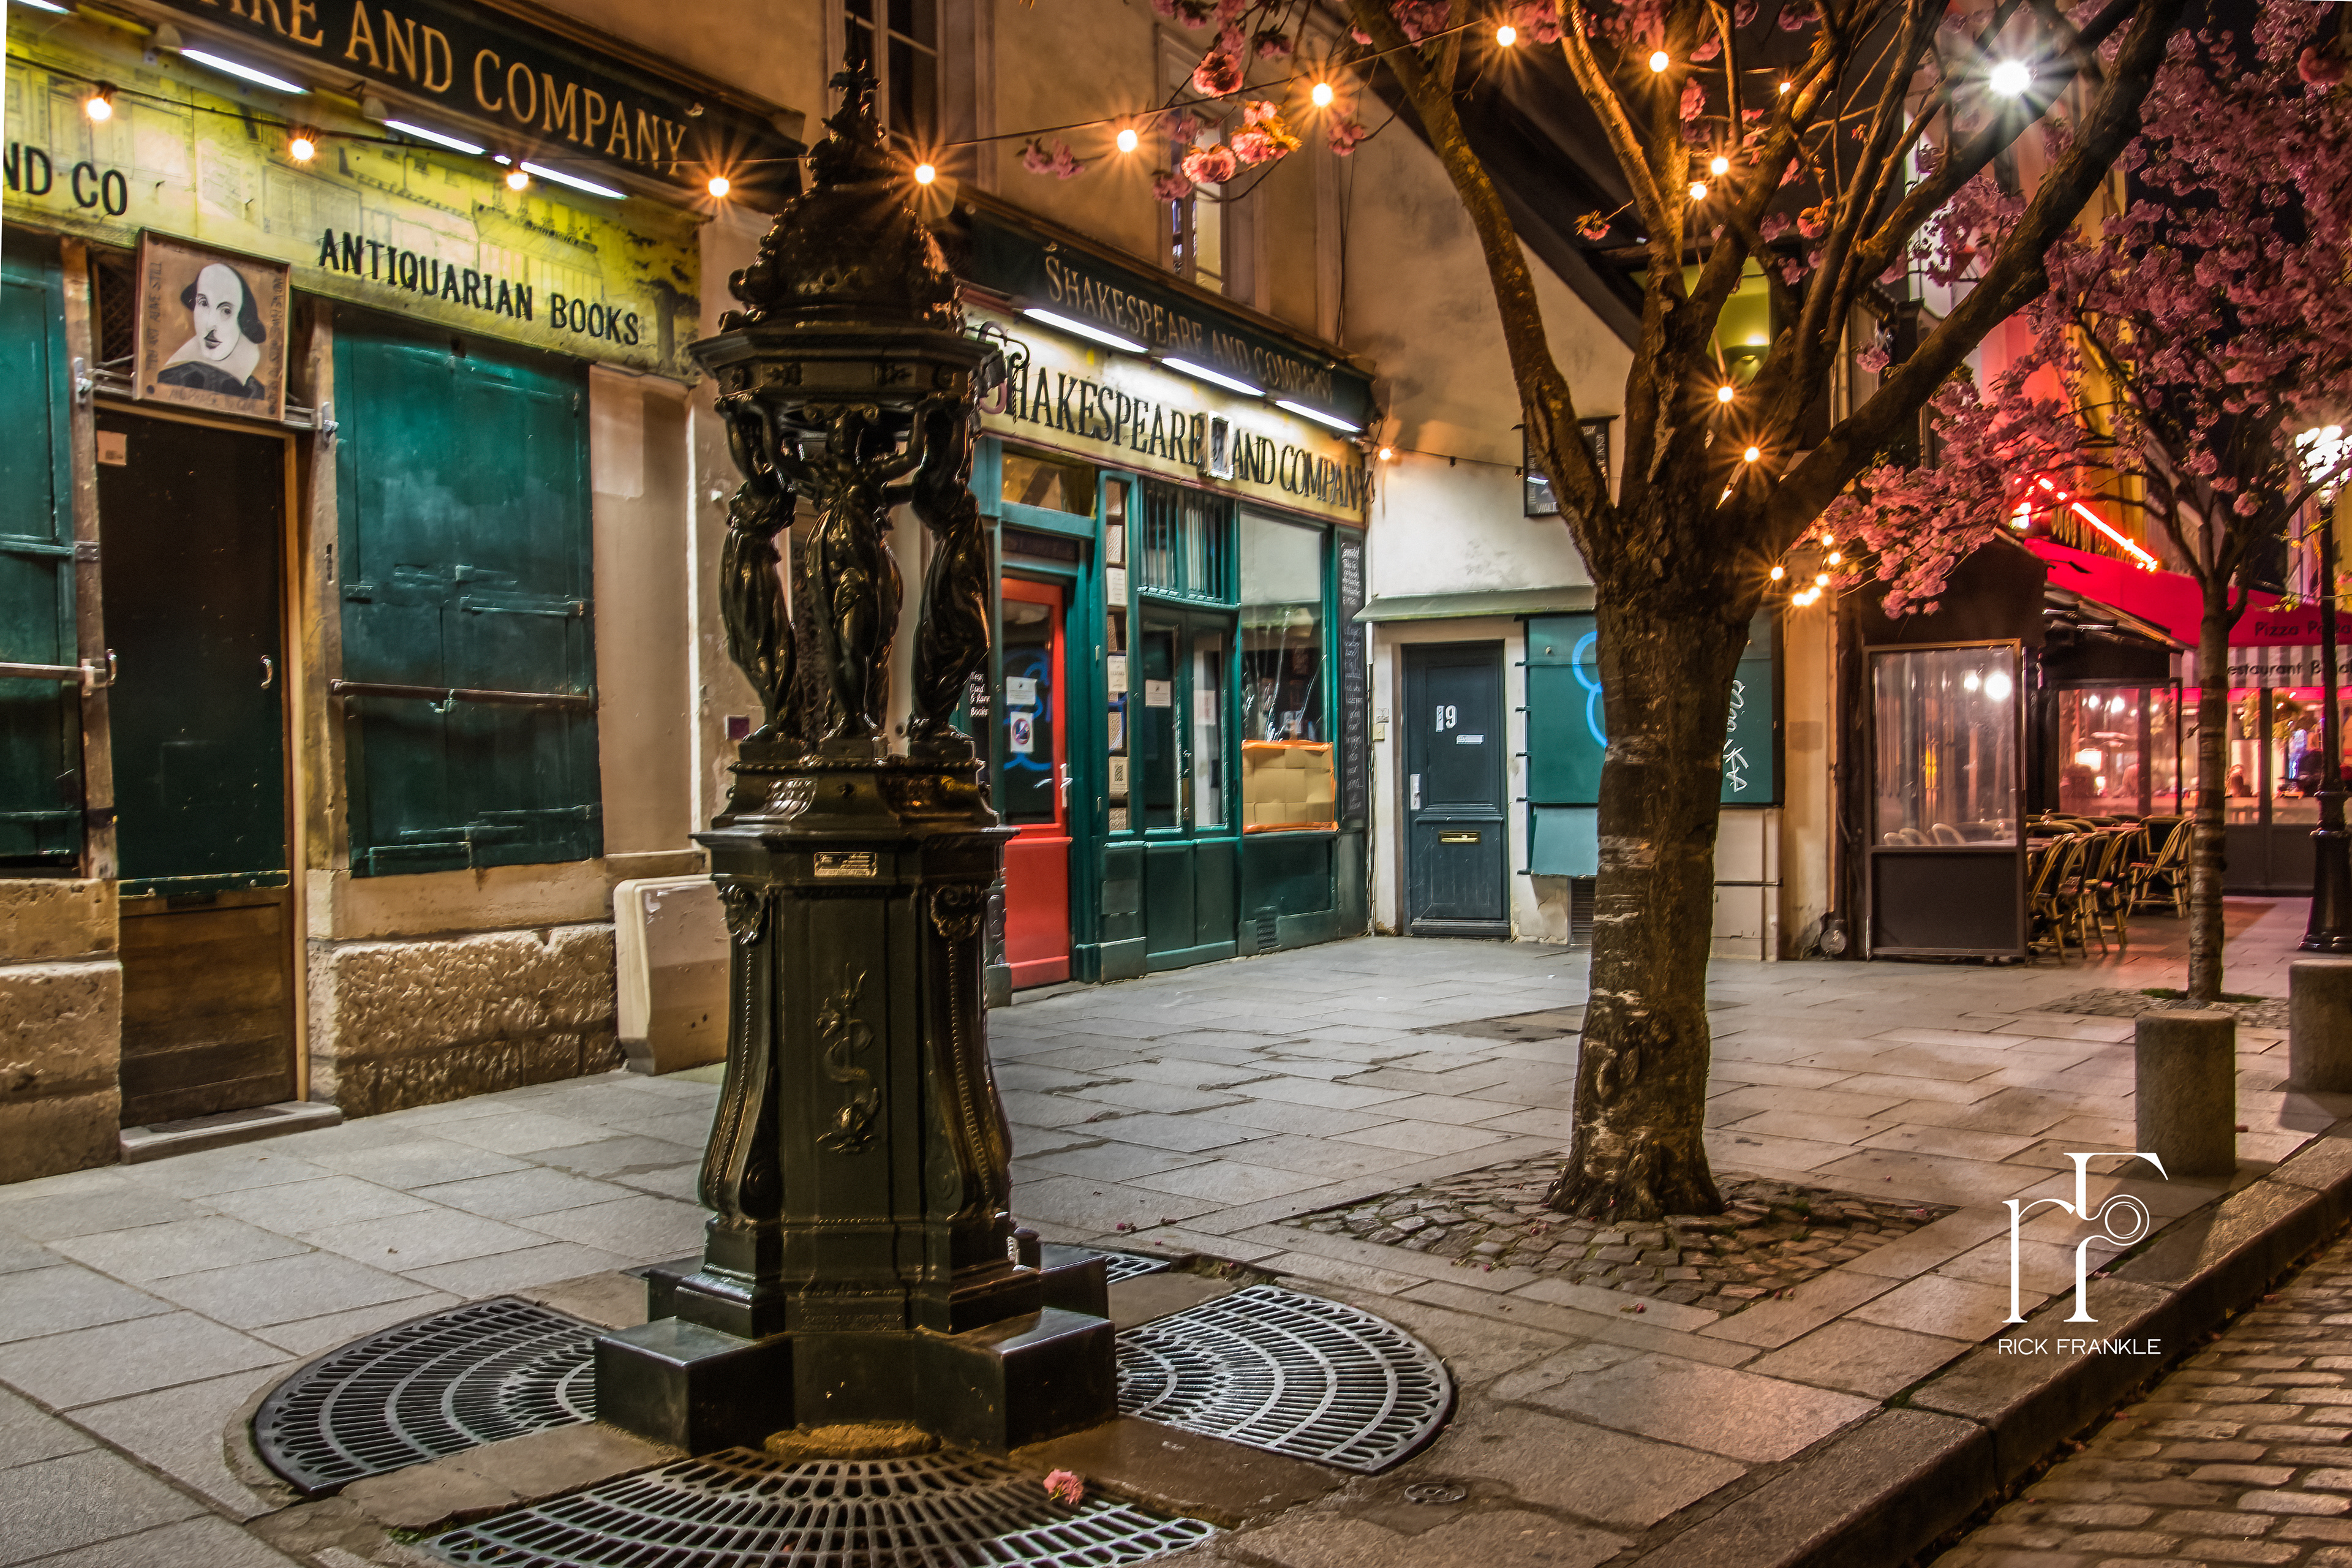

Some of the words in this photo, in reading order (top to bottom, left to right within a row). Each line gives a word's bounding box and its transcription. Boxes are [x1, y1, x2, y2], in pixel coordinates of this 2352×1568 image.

[344, 0, 453, 93] AND
[474, 49, 687, 177] COMPANY
[72, 161, 127, 216] CO
[149, 262, 162, 292] STILL
[318, 228, 533, 321] ANTIQUARIAN
[551, 292, 639, 345] BOOKS
[1045, 255, 1202, 356] SHAKESPEARE
[1212, 329, 1250, 375] AND
[1232, 428, 1276, 484] AND
[1280, 444, 1373, 513] COMPANY
[2255, 621, 2299, 636] Pizza
[2226, 662, 2303, 676] estaurant
